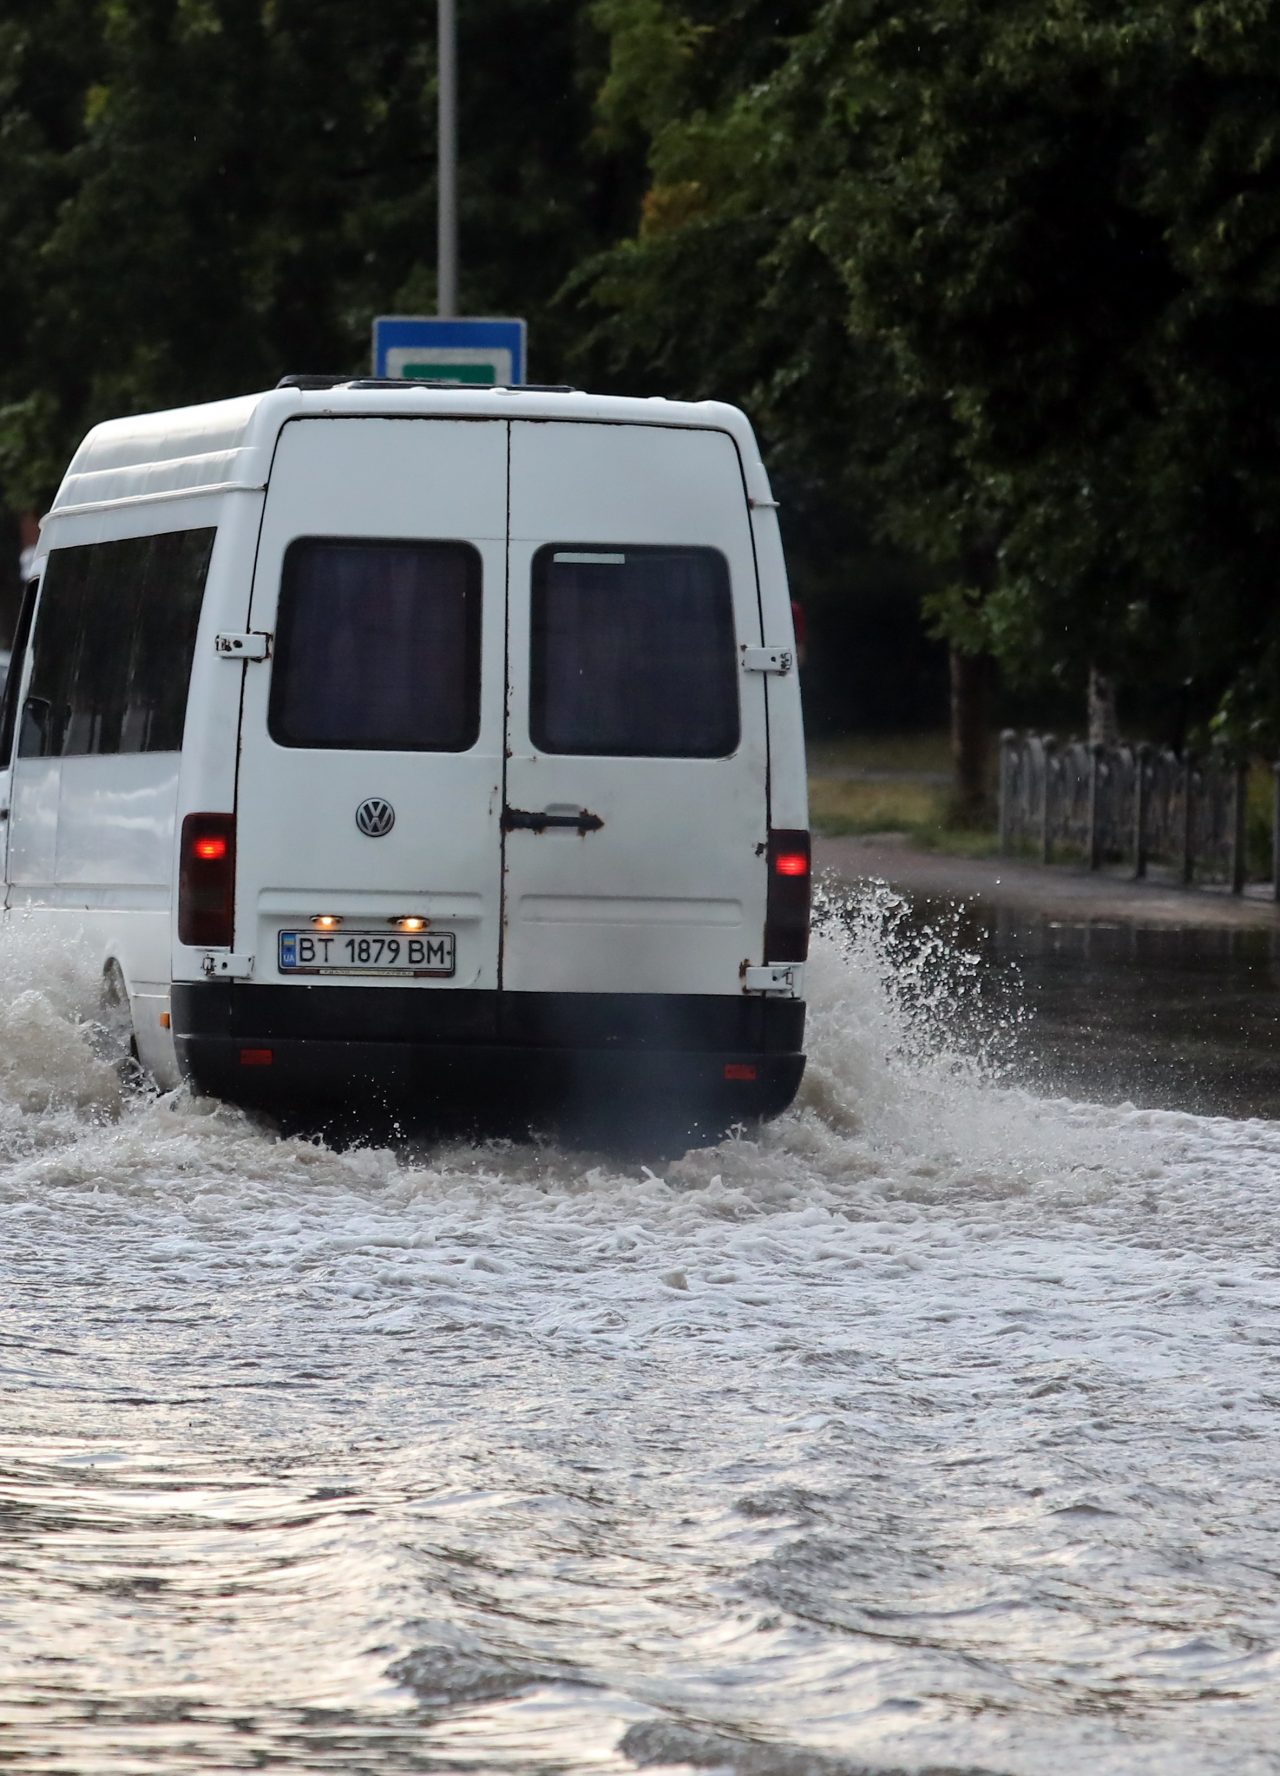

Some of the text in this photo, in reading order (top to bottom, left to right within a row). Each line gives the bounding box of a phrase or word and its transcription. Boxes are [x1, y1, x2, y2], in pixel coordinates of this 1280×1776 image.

[283, 954, 295, 962] UA
[299, 937, 444, 965] BT 1879 BM
